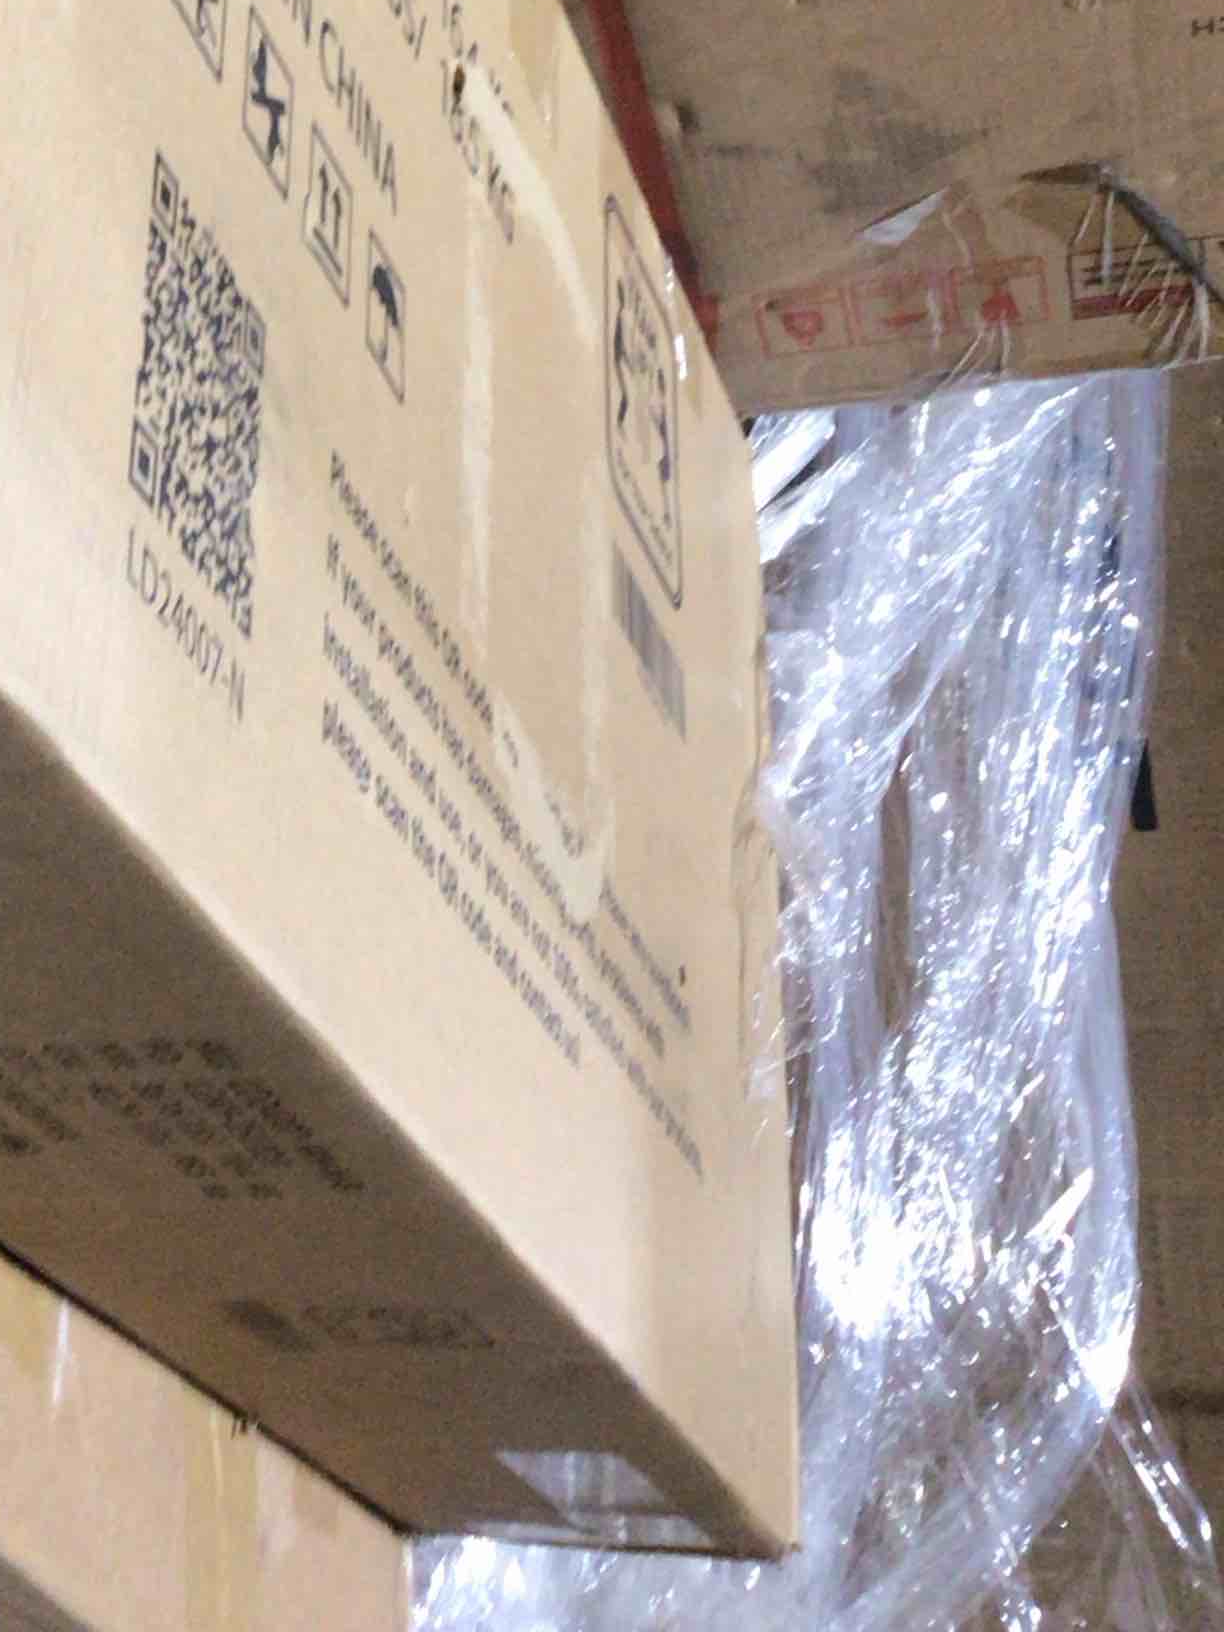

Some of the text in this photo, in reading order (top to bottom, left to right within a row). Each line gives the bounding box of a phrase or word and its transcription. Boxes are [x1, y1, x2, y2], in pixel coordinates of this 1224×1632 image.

[319, 20, 397, 211] CHINA
[330, 452, 378, 551] Please
[380, 539, 412, 603] scan
[412, 585, 441, 649] this
[440, 628, 462, 679] QR
[341, 565, 376, 632] your
[378, 624, 440, 731] products
[375, 775, 409, 839] scan
[411, 818, 436, 878] the
[437, 852, 459, 908] QR
[459, 892, 492, 953] code
[493, 936, 521, 988] and
[518, 971, 567, 1051] contact
[409, 749, 436, 805] and
[484, 856, 509, 907] you
[509, 890, 533, 937] are
